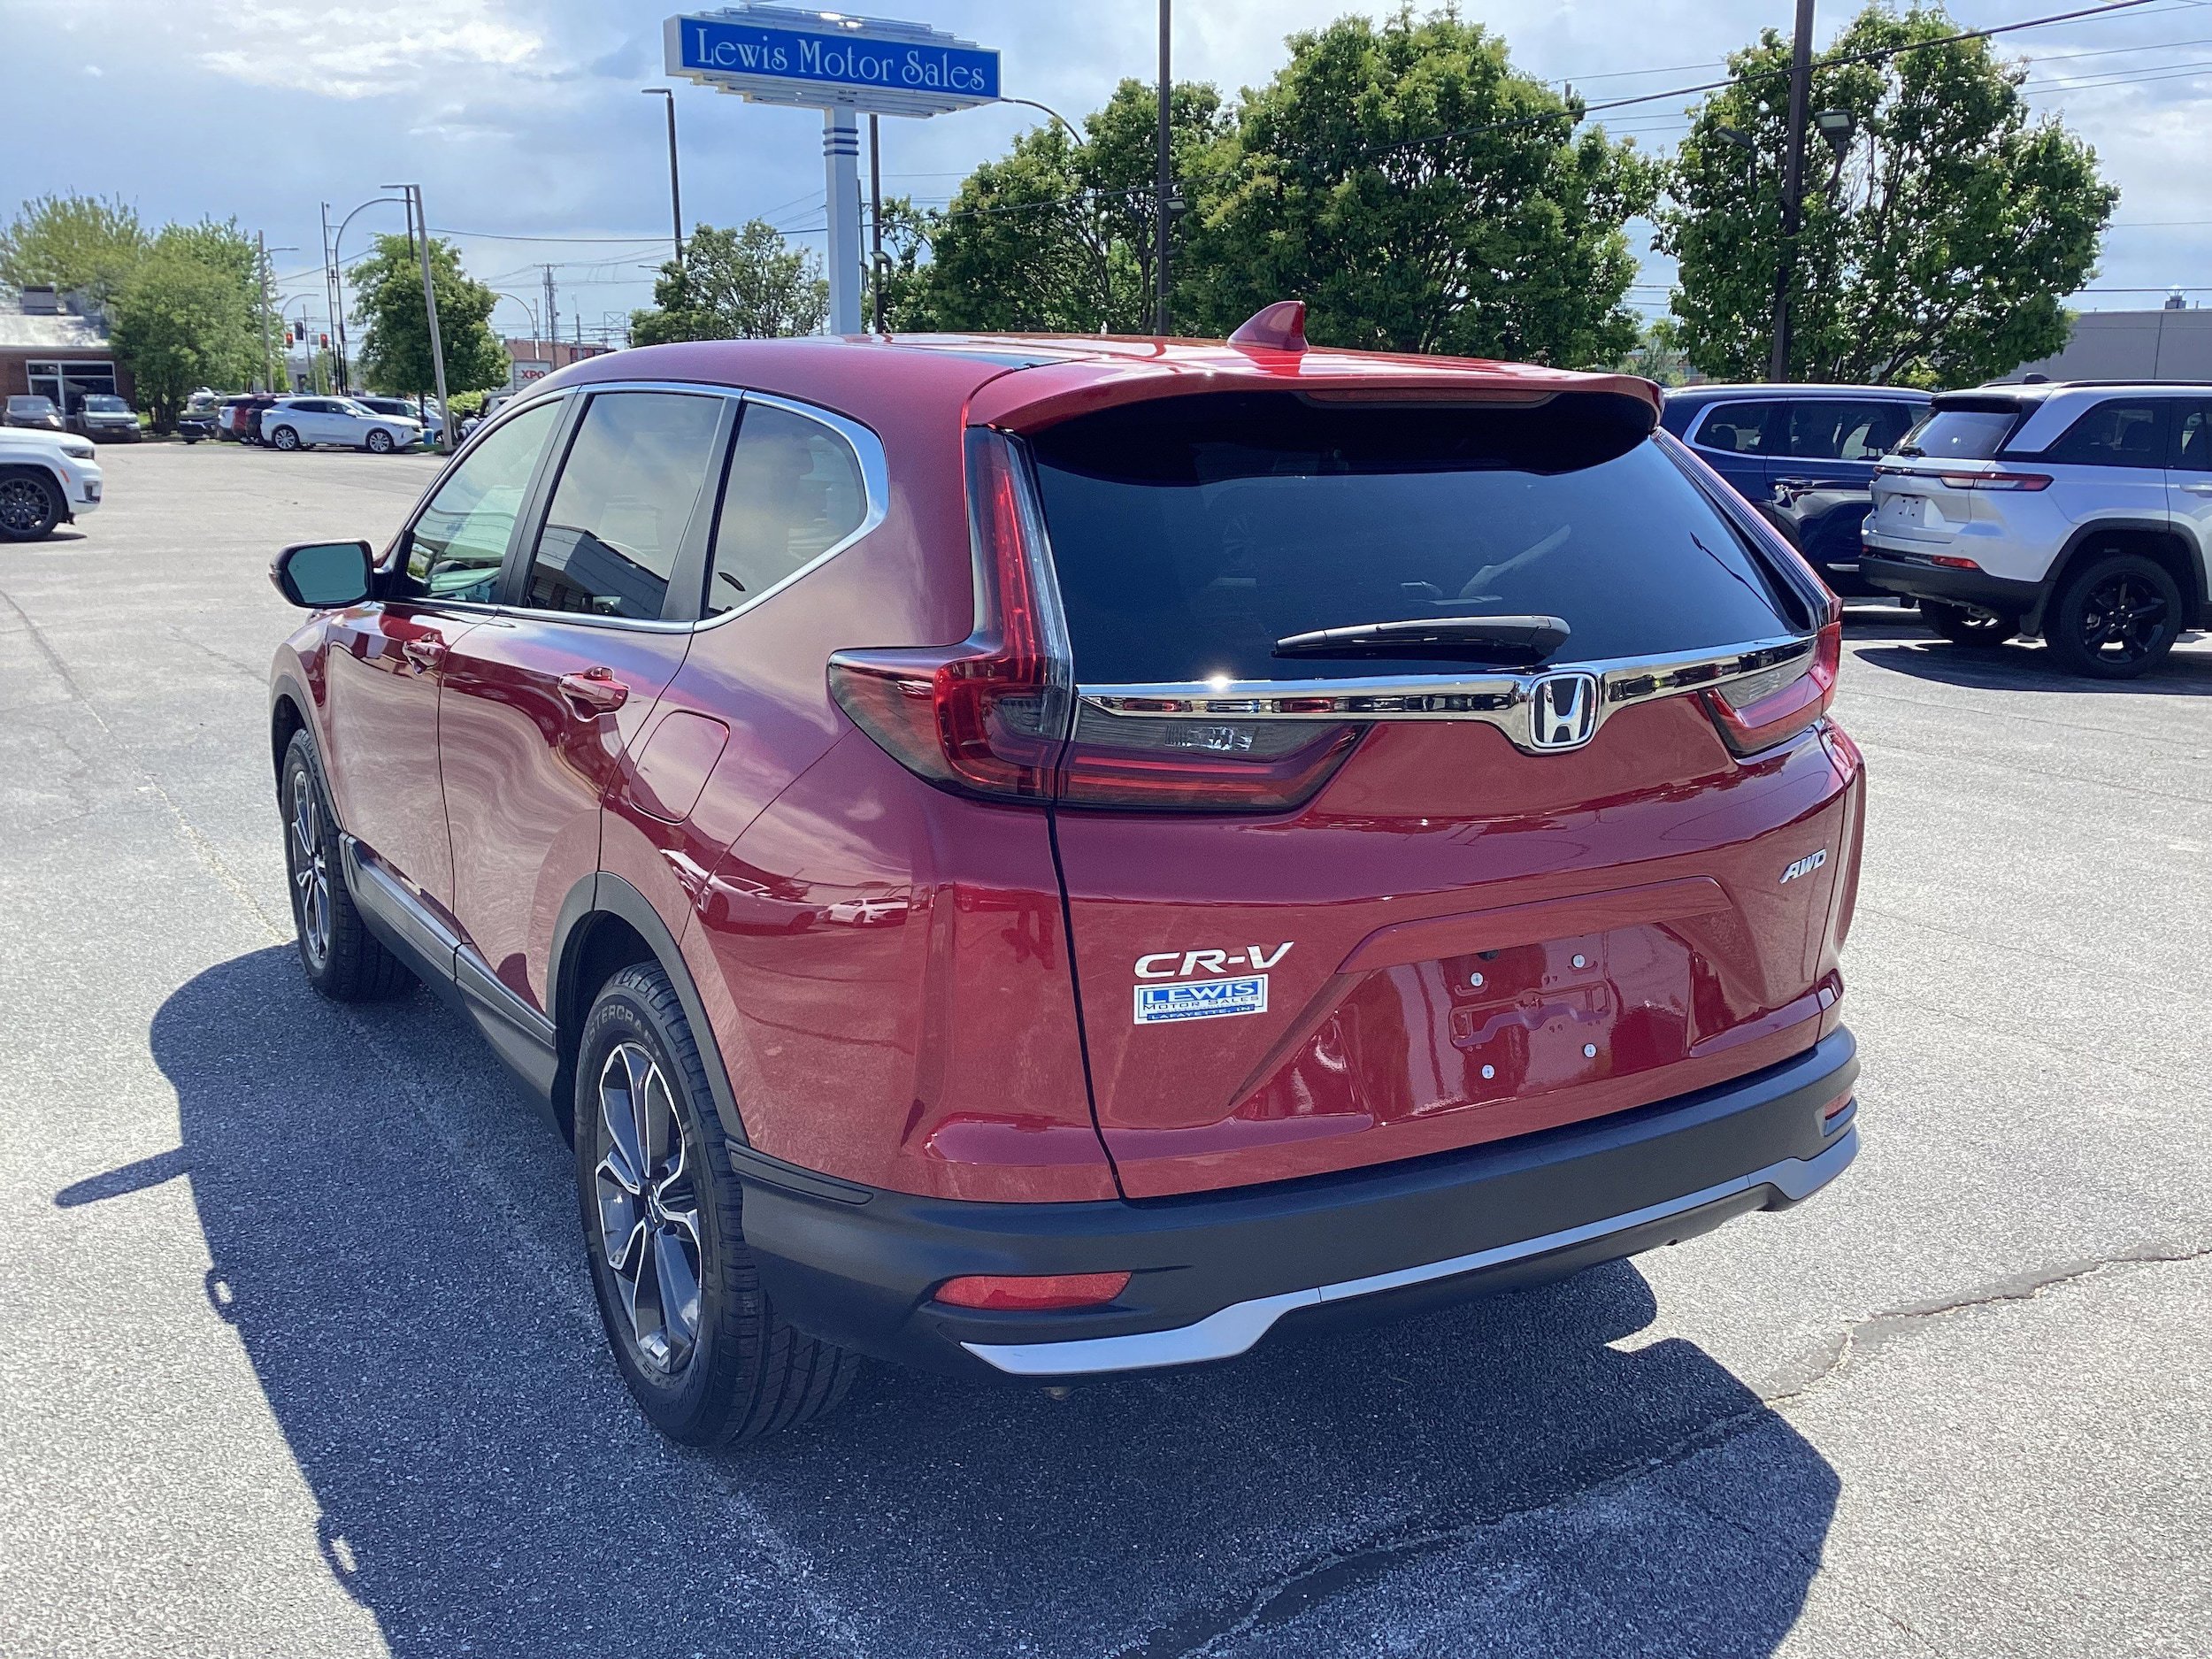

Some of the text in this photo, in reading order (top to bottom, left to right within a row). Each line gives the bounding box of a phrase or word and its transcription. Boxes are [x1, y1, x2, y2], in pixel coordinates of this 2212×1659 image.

[695, 27, 986, 90] Lewis Motor Sales
[521, 369, 546, 380] XPO
[1778, 848, 1827, 885] AWD
[1133, 941, 1294, 979] CR-V
[1144, 1001, 1200, 1010] MOTOR
[1208, 995, 1259, 1005] SALES
[1147, 982, 1256, 1004] LEWIS
